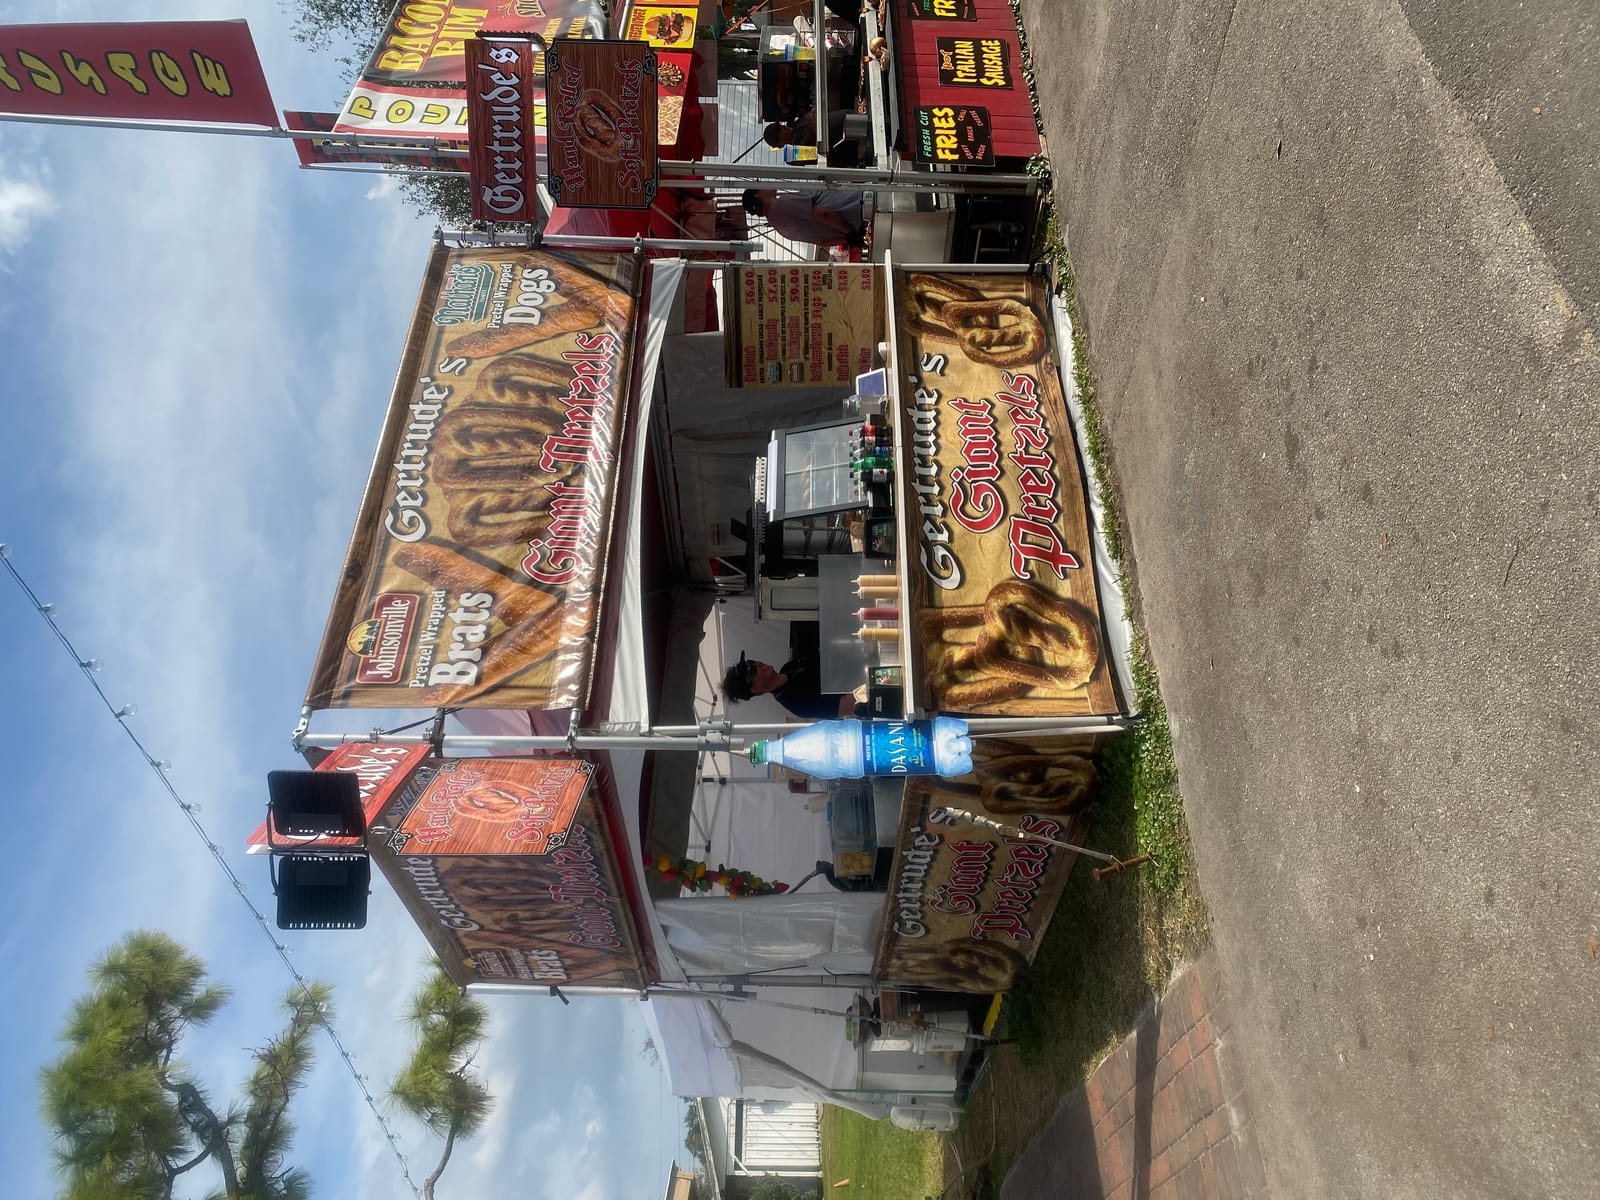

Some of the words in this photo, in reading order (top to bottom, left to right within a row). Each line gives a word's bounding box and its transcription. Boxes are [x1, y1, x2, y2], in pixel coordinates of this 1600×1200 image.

[952, 40, 978, 82] ITALIAN
[979, 40, 1006, 86] SAUSAGE
[555, 56, 585, 130] Rolled
[615, 58, 643, 140] Pretzels
[919, 110, 929, 126] CUT
[477, 47, 525, 214] Gertrude's
[922, 129, 932, 157] FRESH
[932, 107, 960, 160] FRIES
[551, 131, 586, 192] Hand
[617, 139, 646, 192] Soft
[432, 264, 482, 326] Nathan's
[493, 263, 513, 298] Wrapped
[503, 268, 557, 325] Dogs
[744, 271, 756, 304] $6.00
[767, 269, 778, 302] $7.00
[789, 268, 800, 302] $9.00
[486, 300, 506, 329] Pretzel
[539, 332, 615, 472] Pretzels
[384, 356, 467, 543] Gertrude's
[906, 352, 961, 590] Gertrude's
[947, 398, 1003, 534] Giant
[995, 370, 1080, 580] Pretzels
[521, 481, 592, 584] Giant
[366, 599, 411, 678] Johnsonville
[420, 590, 447, 642] Wrapped
[428, 592, 494, 686] Brats
[409, 645, 434, 688] Pretzel
[884, 722, 909, 773] DASANI
[414, 803, 453, 845] Hand
[507, 807, 555, 843] Soft
[928, 840, 994, 915] Giant
[970, 815, 1060, 940] Pretzels
[568, 905, 621, 947] Giant
[528, 949, 568, 980] Brats
